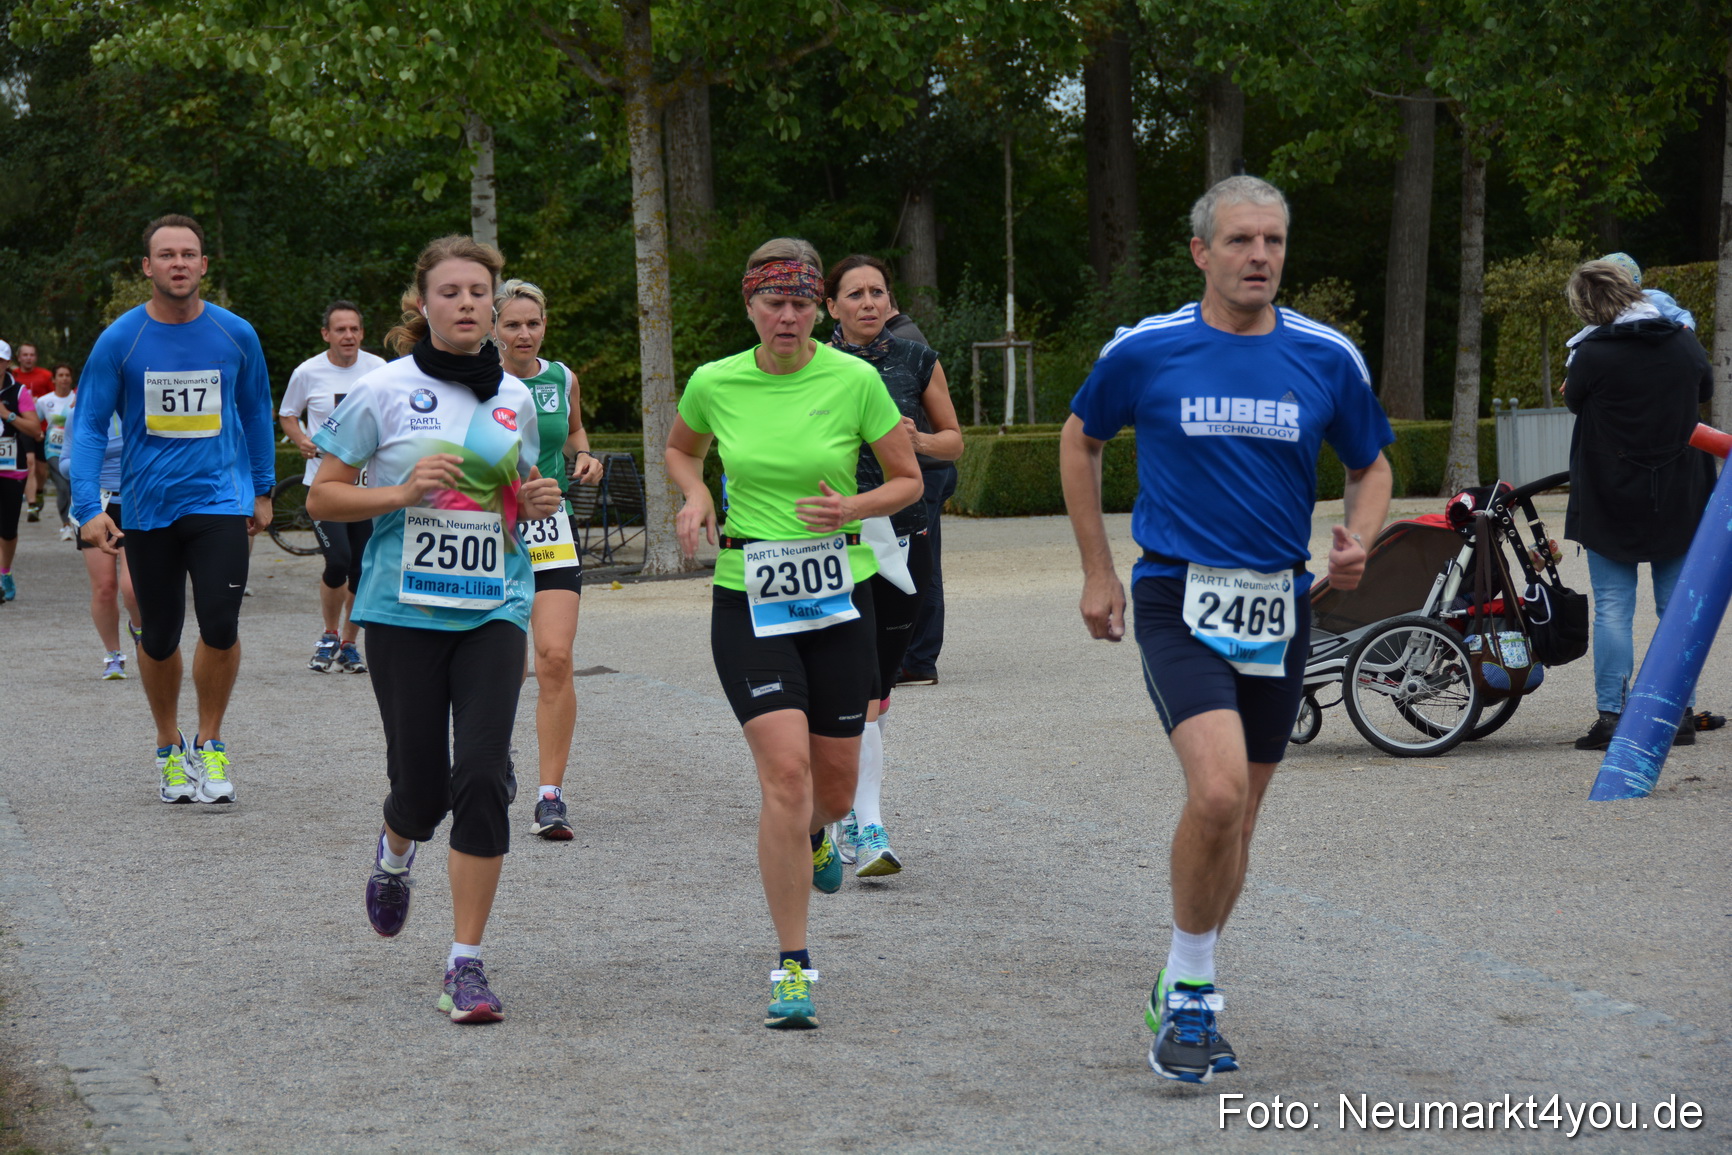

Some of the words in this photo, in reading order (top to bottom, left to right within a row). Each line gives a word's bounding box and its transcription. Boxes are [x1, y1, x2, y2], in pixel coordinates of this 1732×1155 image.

[173, 377, 209, 385] Neumarkt
[161, 388, 207, 413] 517
[410, 417, 442, 425] PARTL
[1180, 396, 1300, 428] HUBER
[1206, 424, 1295, 439] TECHNOLOGY
[407, 516, 444, 528] PARTL
[445, 519, 491, 532] Neumarkt
[519, 515, 560, 545] 233
[317, 526, 330, 548] odlo
[413, 531, 497, 573] 2500
[529, 549, 556, 562] Heike
[746, 546, 780, 562] PARTL
[781, 541, 831, 557] Neumarkt
[406, 574, 501, 597] Tamara-Lilian
[755, 554, 844, 599] 2309
[1190, 573, 1231, 588] PARTL
[1233, 578, 1280, 591] Neumarkt
[787, 602, 823, 618] Karin
[1197, 591, 1286, 636] 2469
[1229, 642, 1257, 660] Uwe
